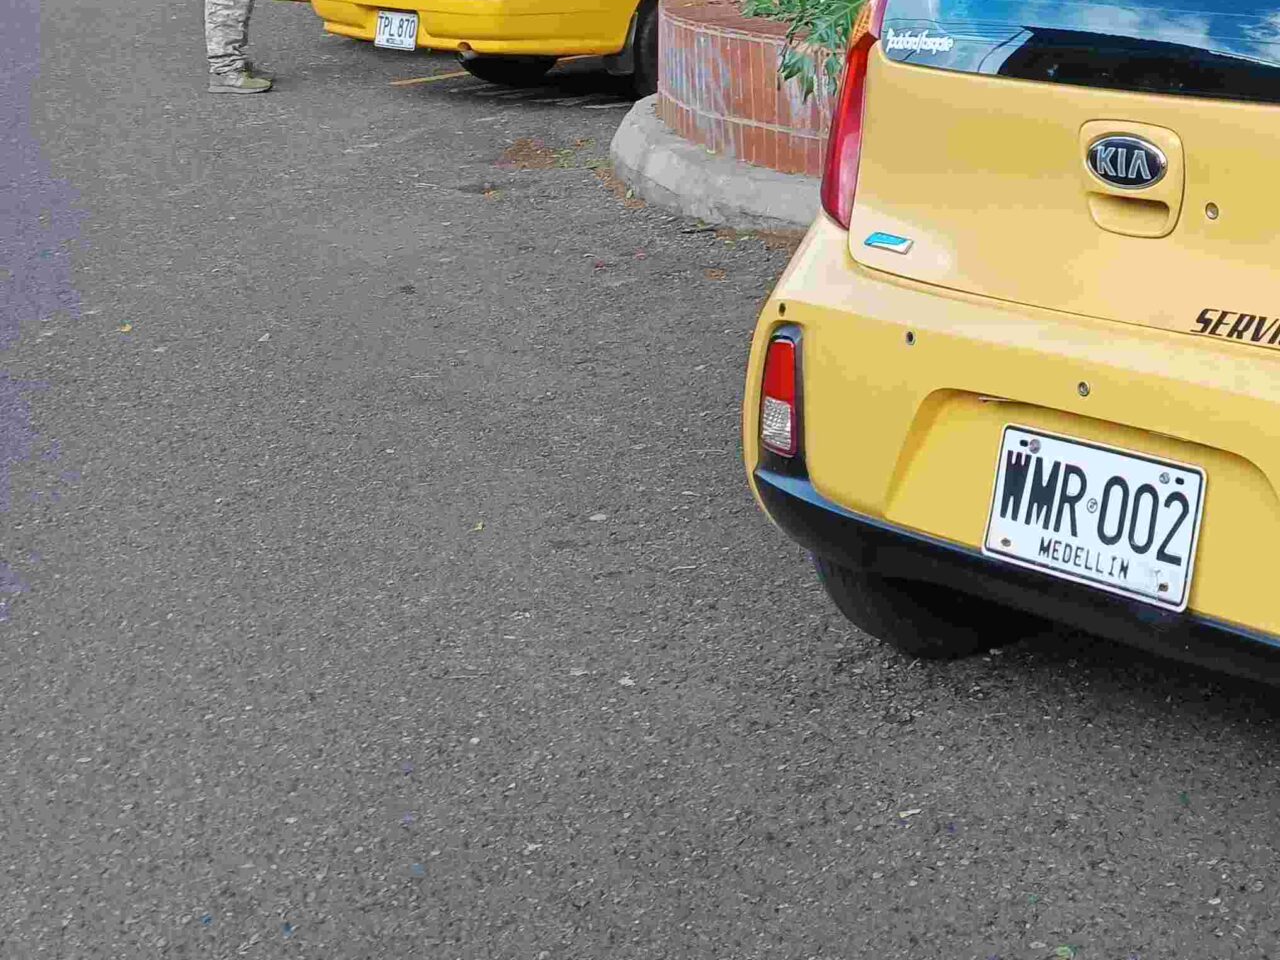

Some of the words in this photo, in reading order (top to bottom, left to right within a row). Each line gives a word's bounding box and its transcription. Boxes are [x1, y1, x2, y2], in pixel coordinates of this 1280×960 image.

[378, 15, 395, 37] TPL
[397, 18, 416, 39] 870
[1096, 145, 1152, 180] KIA
[1000, 449, 1088, 538] WMR
[1096, 475, 1190, 567] 002
[1037, 536, 1130, 580] MEDELLIN
